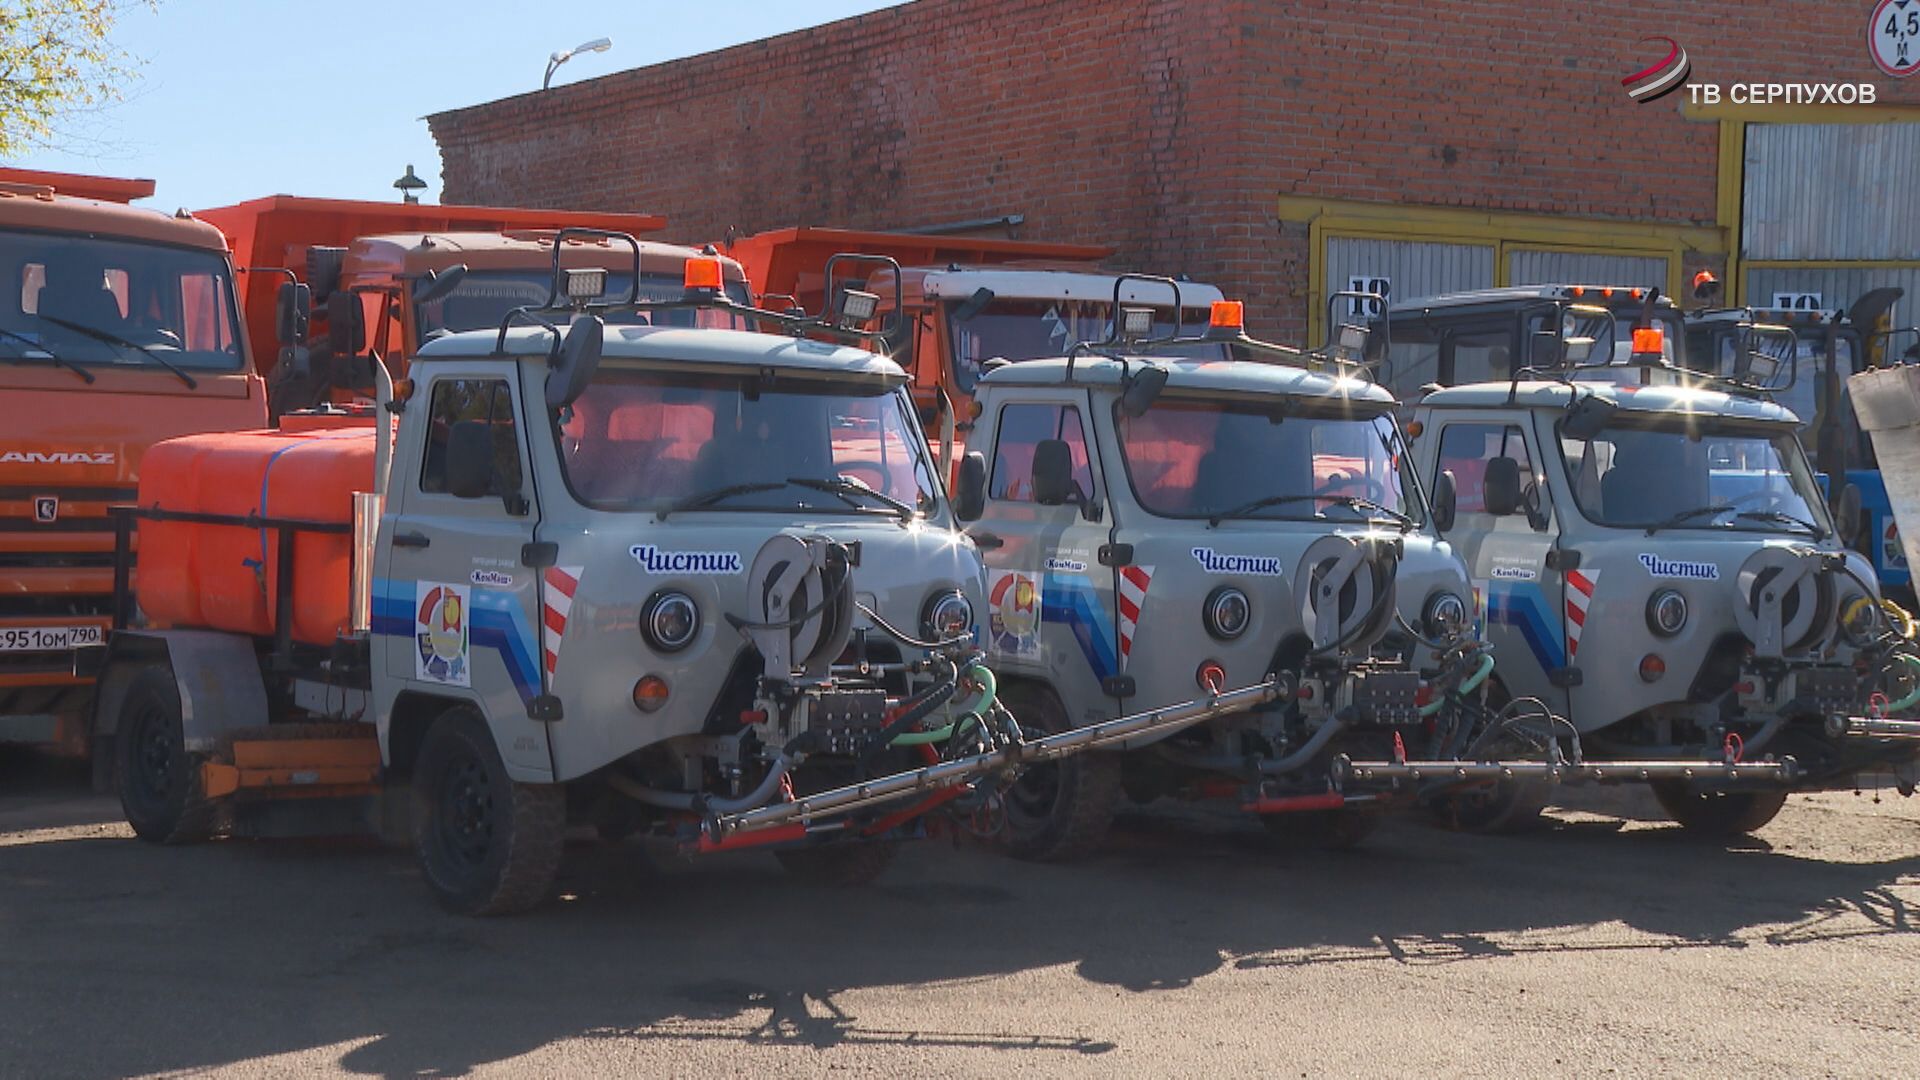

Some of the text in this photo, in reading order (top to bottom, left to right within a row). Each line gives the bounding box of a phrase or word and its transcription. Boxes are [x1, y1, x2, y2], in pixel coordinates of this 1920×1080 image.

[1885, 11, 1919, 41] 4,5
[632, 546, 740, 571] Чистик
[1193, 549, 1280, 574] Чистик
[1640, 555, 1718, 578] Чистик
[70, 628, 98, 642] 790
